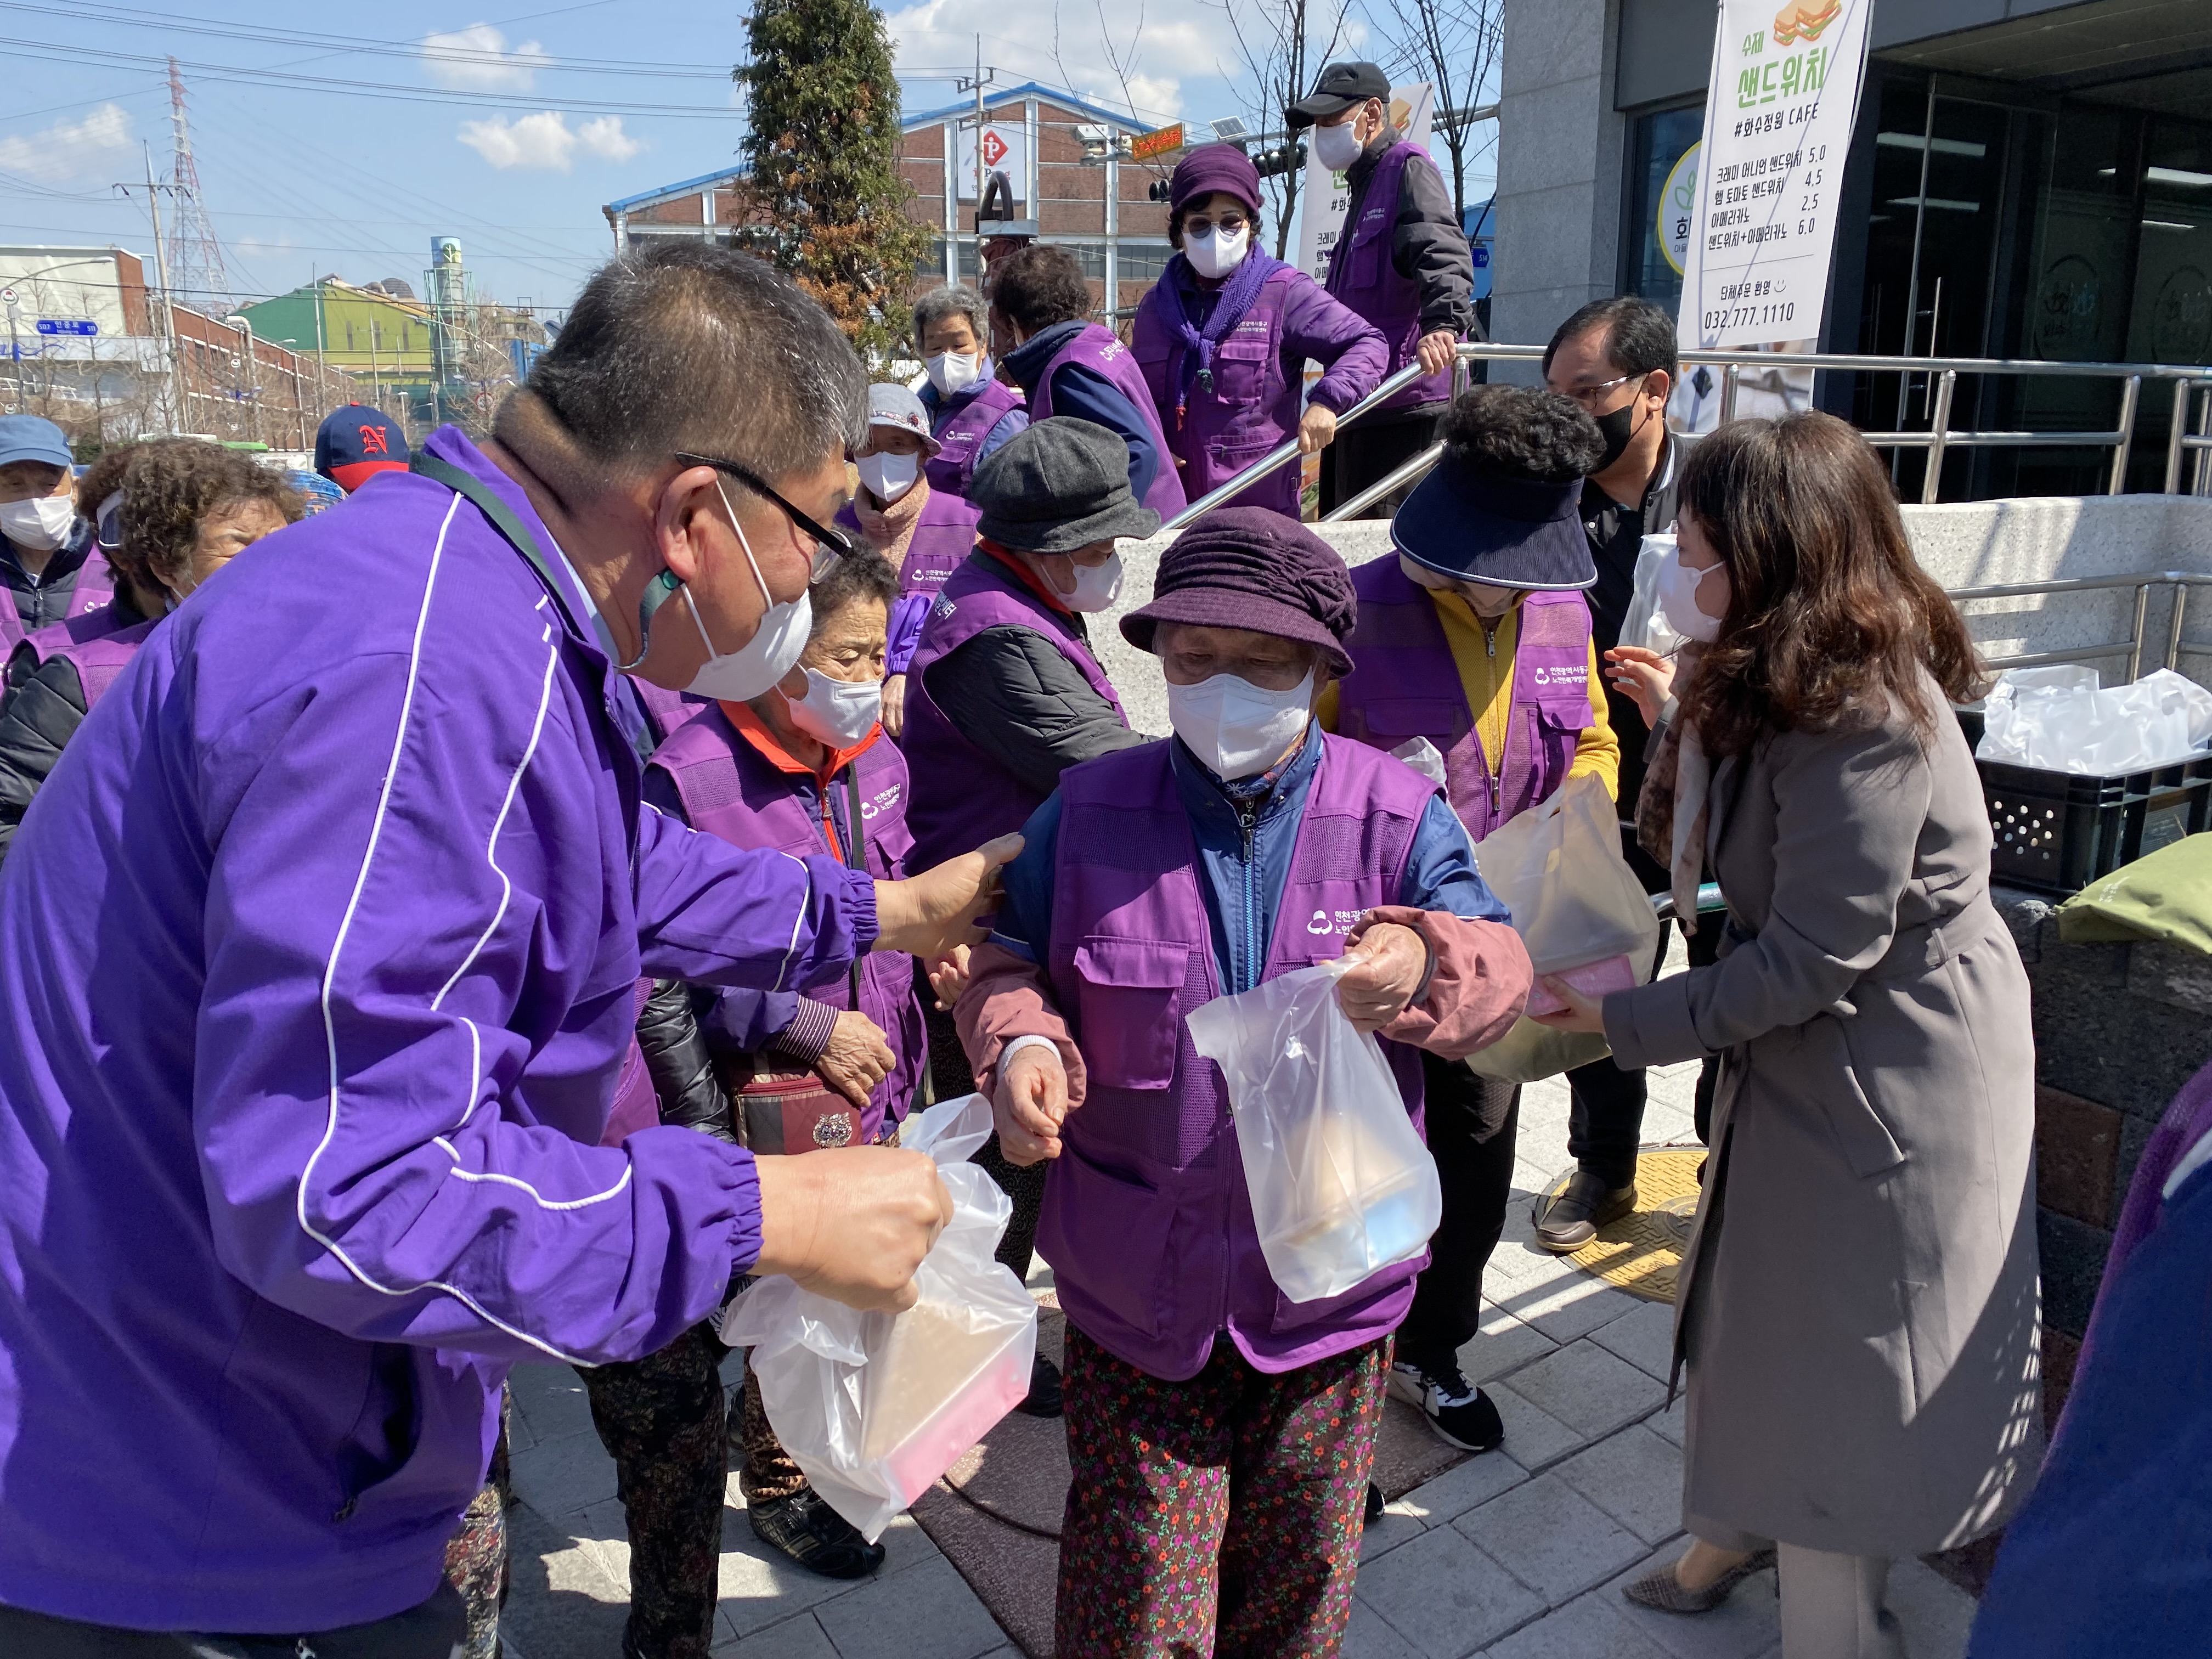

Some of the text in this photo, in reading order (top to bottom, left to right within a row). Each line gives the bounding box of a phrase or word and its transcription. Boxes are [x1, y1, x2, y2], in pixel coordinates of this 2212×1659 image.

[1742, 30, 1765, 57] 수제
[1737, 46, 1827, 109] 샌드위치
[1734, 102, 1819, 138] #화수정원 CAFE
[1717, 144, 1826, 184] 크래미 어니언 샌드위치 5.0
[1715, 169, 1822, 206] 햄 토마토 샌드위치 4.5
[1711, 193, 1819, 228] 아메리카노 2.5
[1317, 231, 1336, 245] 크래미
[1675, 216, 1692, 240] 화
[1708, 217, 1815, 250] 샌드위치+아메리카노 6.0
[1674, 244, 1688, 253] 마을
[1720, 280, 1771, 300] 단체주문 환영
[1705, 302, 1795, 329] 032.777.1110
[359, 425, 388, 454] N
[1552, 675, 1588, 684] 노인인력개발센
[1334, 924, 1355, 935] 노인
